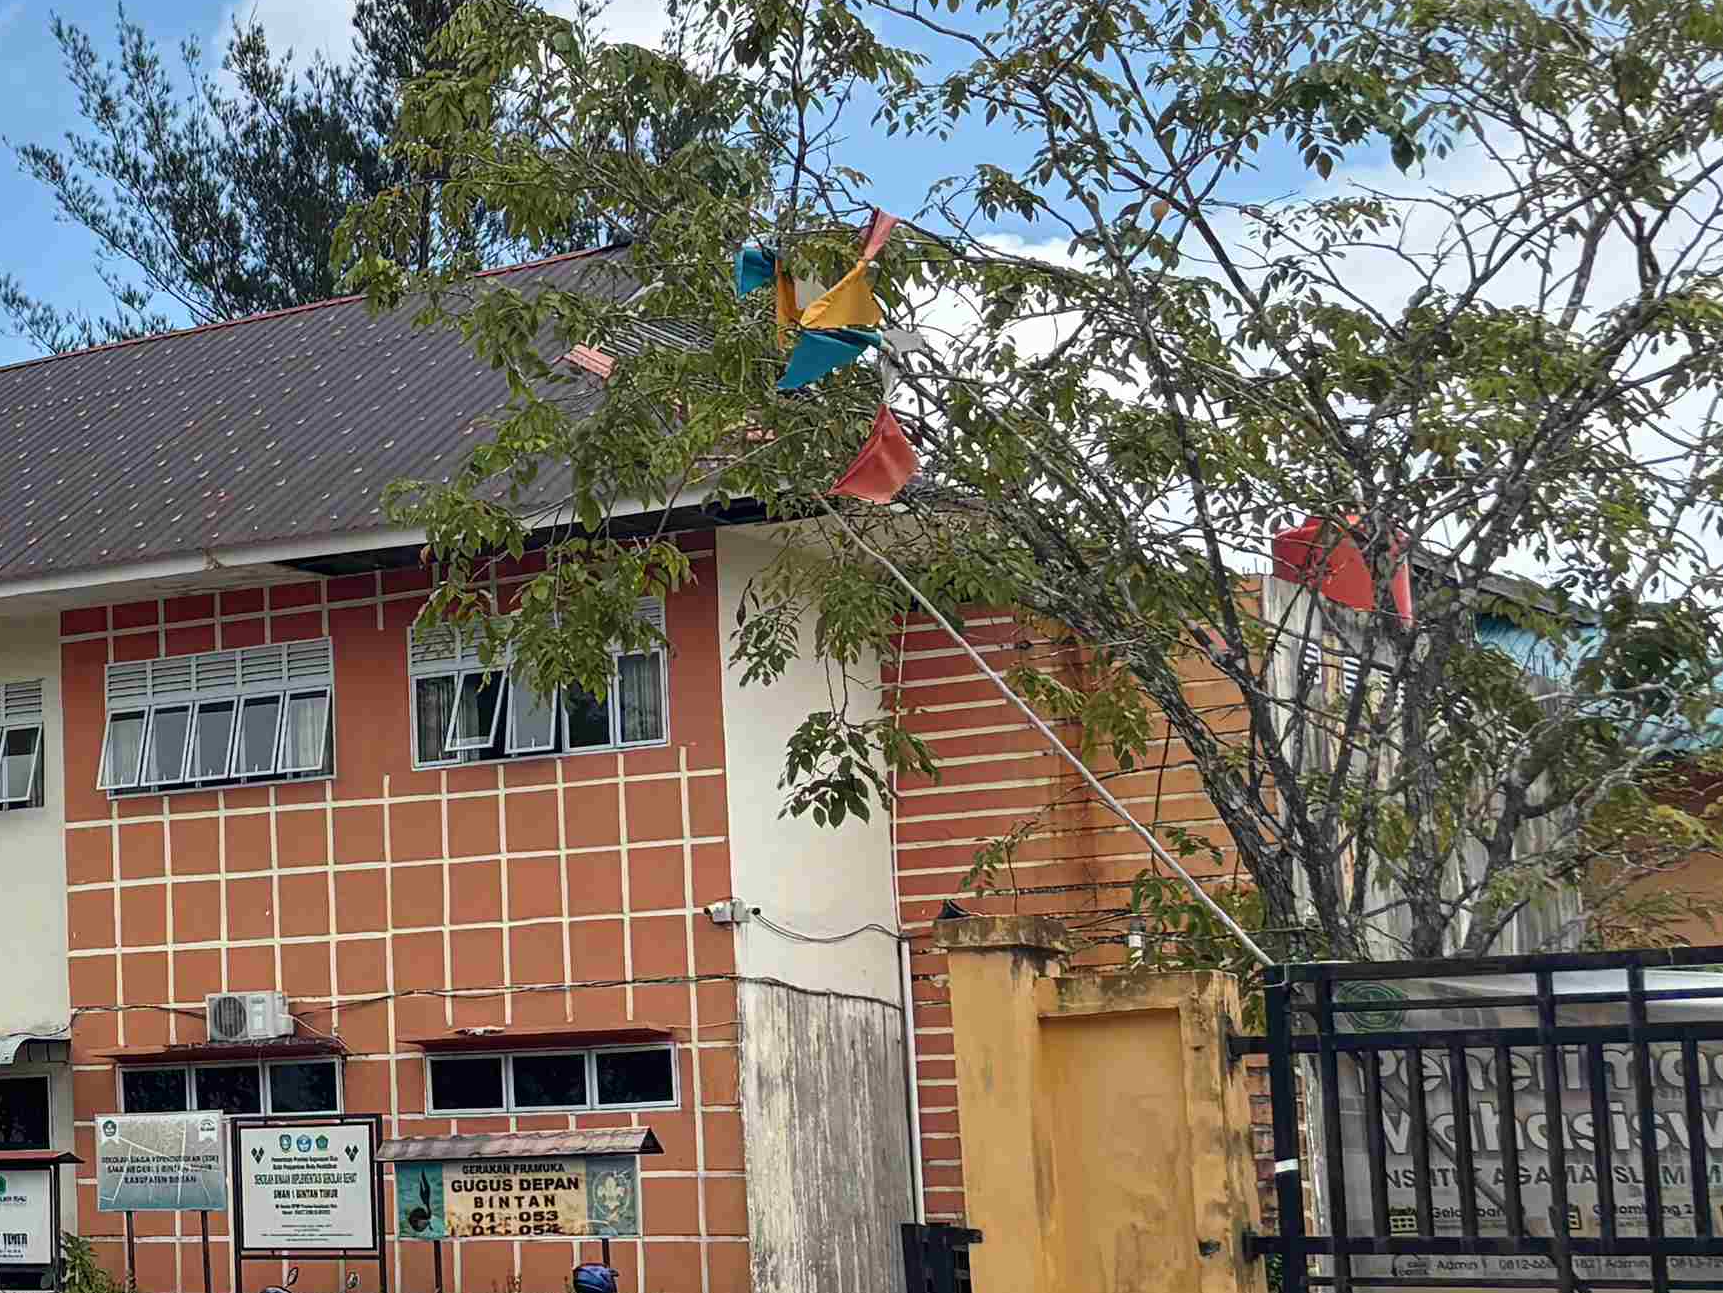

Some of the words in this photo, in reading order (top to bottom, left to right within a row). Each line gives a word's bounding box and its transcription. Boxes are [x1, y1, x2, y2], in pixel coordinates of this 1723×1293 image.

[462, 1164, 512, 1175] GERAKAN
[513, 1163, 565, 1174] PRAMUKA
[451, 1179, 513, 1193] GUGUS
[519, 1177, 579, 1191] DEPAN
[474, 1195, 556, 1208] BINTAN
[472, 1211, 495, 1223] 01
[518, 1210, 559, 1223] 053
